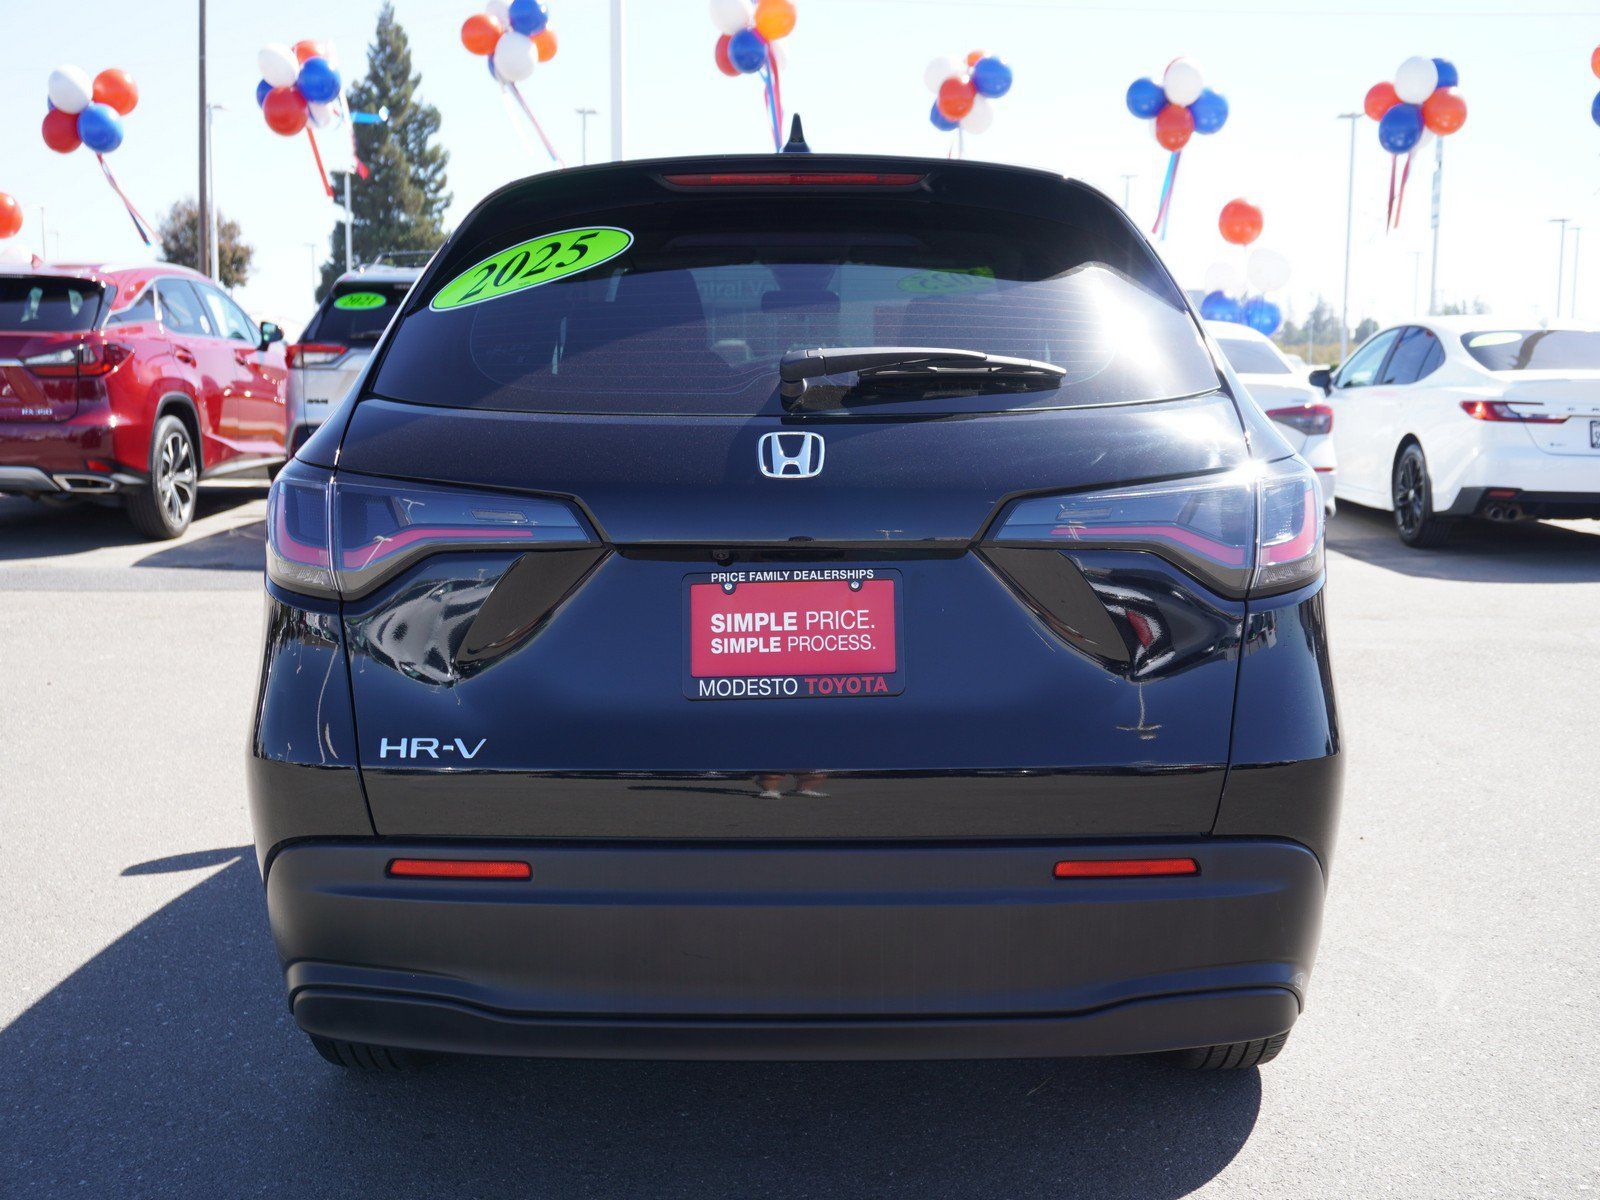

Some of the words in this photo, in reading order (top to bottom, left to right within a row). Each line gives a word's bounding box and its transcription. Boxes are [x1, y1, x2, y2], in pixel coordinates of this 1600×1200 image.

[457, 231, 600, 303] 2025
[711, 573, 746, 583] PRICE
[750, 571, 790, 582] FAMILY
[794, 569, 874, 581] DEALERSHIPS
[710, 611, 798, 633] SIMPLE
[806, 610, 875, 630] PRICE.
[710, 636, 781, 654] SIMPLE
[788, 634, 876, 651] PROCESS.
[699, 678, 798, 697] MODESTO
[805, 676, 889, 694] TOYOTA
[380, 737, 487, 759] HR-V
